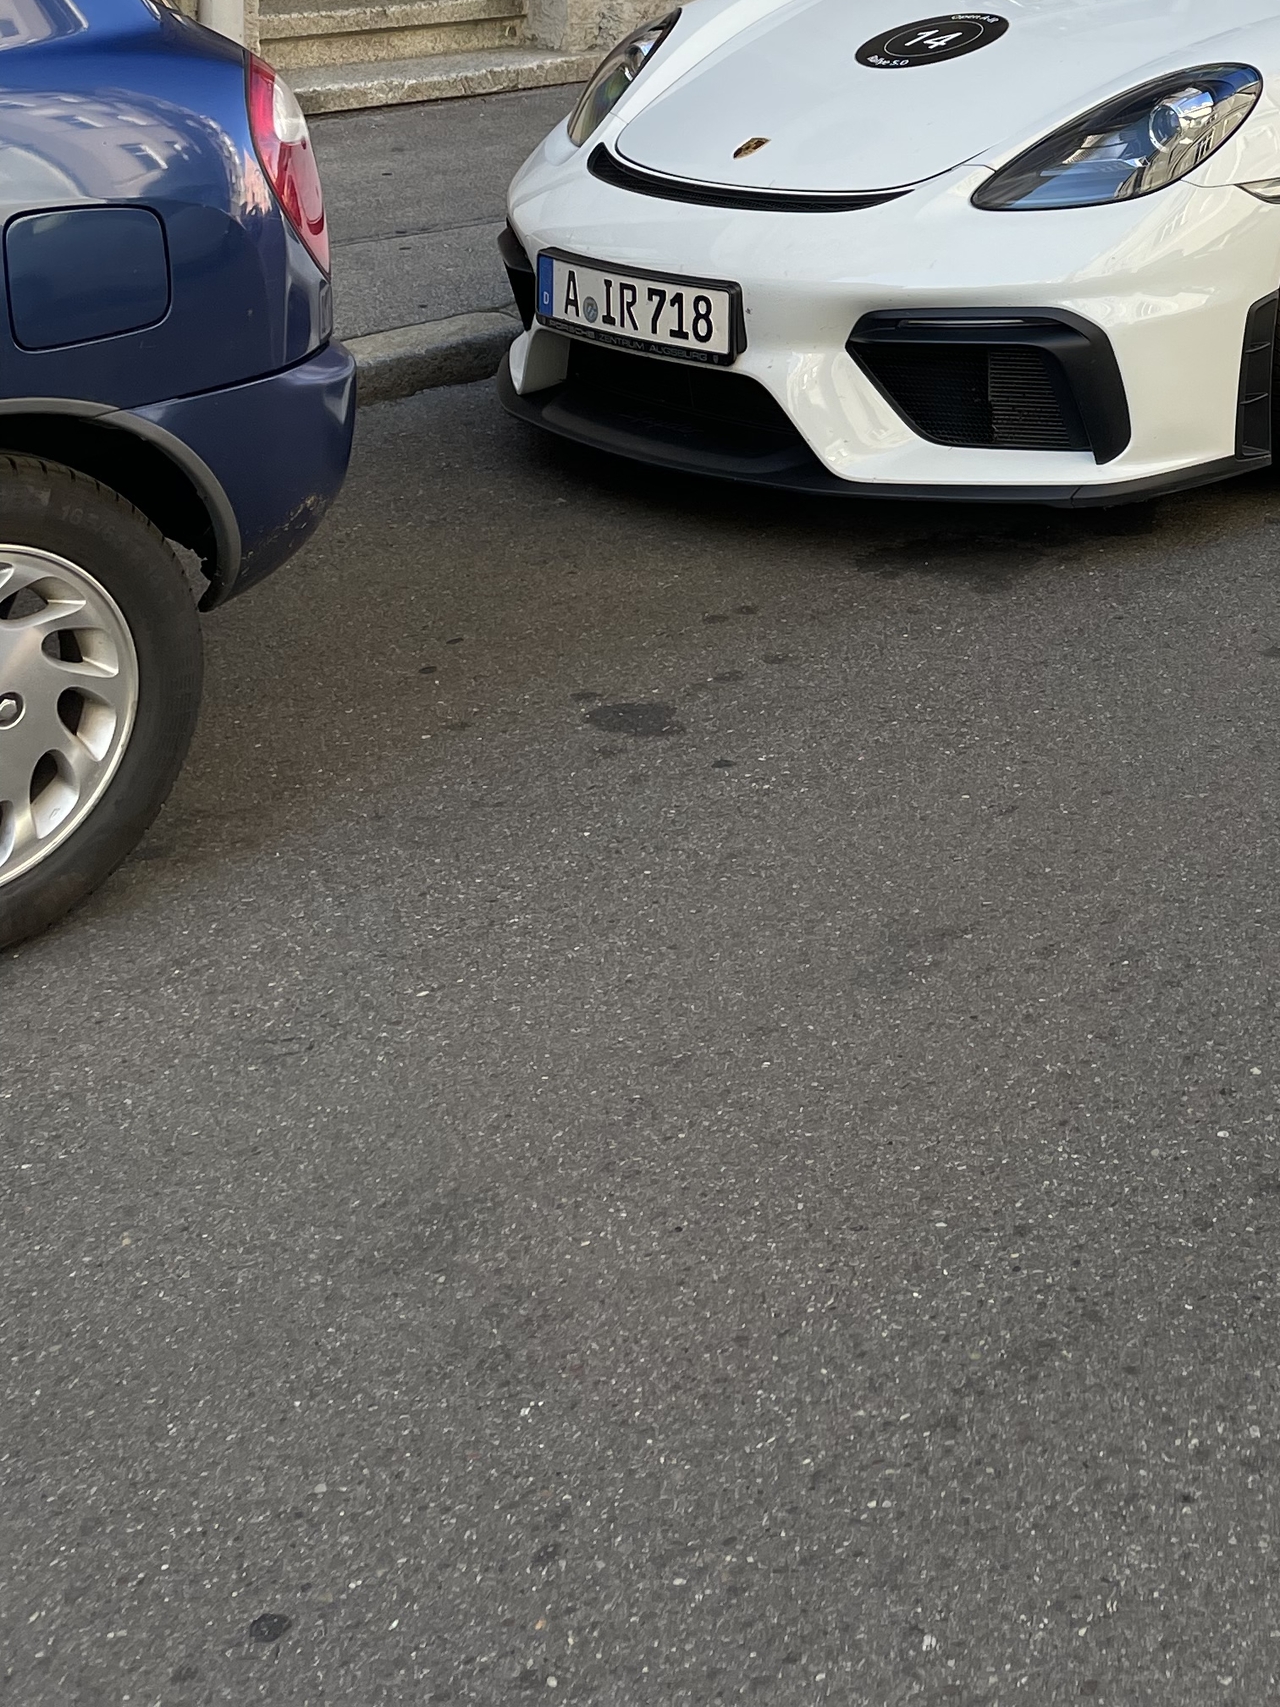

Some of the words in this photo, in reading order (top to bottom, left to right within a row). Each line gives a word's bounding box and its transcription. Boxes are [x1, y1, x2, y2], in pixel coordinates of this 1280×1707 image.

[904, 29, 963, 50] 14
[543, 291, 551, 305] D
[564, 269, 580, 318] A
[602, 279, 639, 331] IR
[647, 287, 714, 344] 718
[599, 334, 645, 351] ZENTRUM
[649, 344, 708, 362] AUGSBURG
